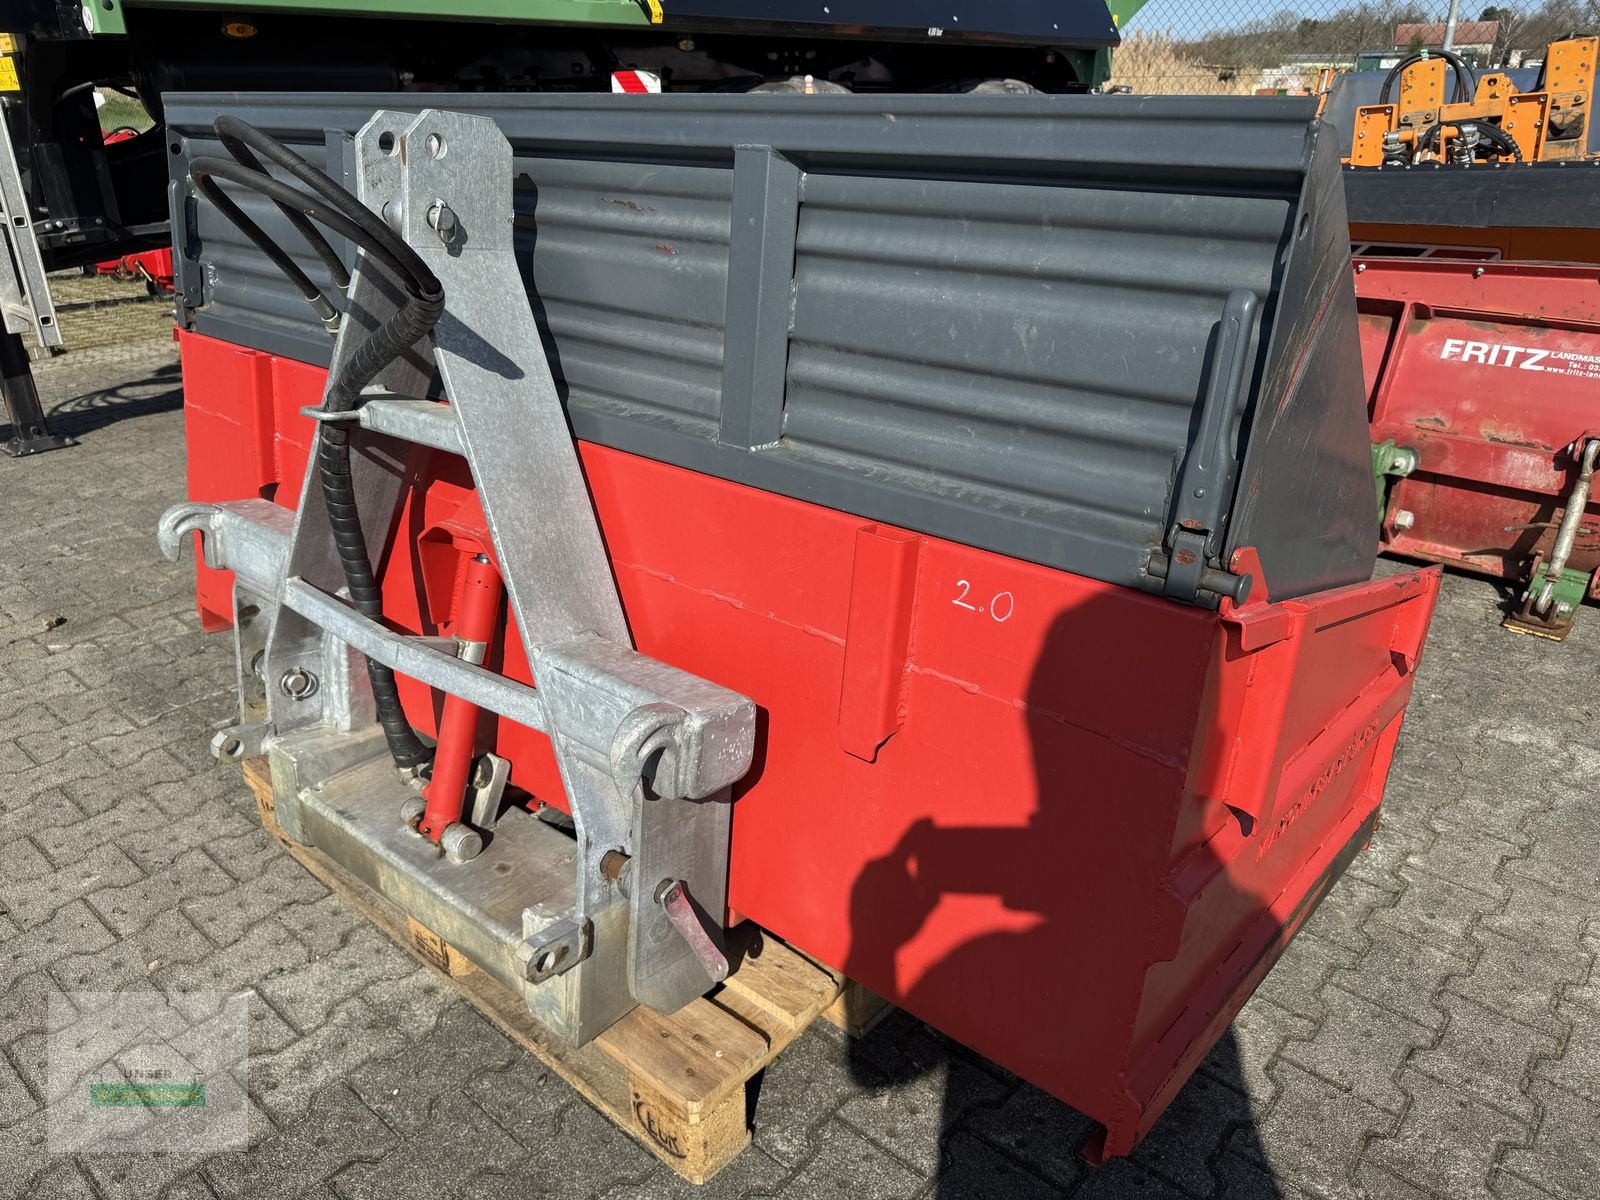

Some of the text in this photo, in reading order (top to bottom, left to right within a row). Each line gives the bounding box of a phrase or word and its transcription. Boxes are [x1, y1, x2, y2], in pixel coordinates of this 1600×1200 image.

[1440, 338, 1549, 371] FRITZ
[1546, 366, 1600, 379] www.fritz-lan
[952, 580, 1014, 622] 2.0
